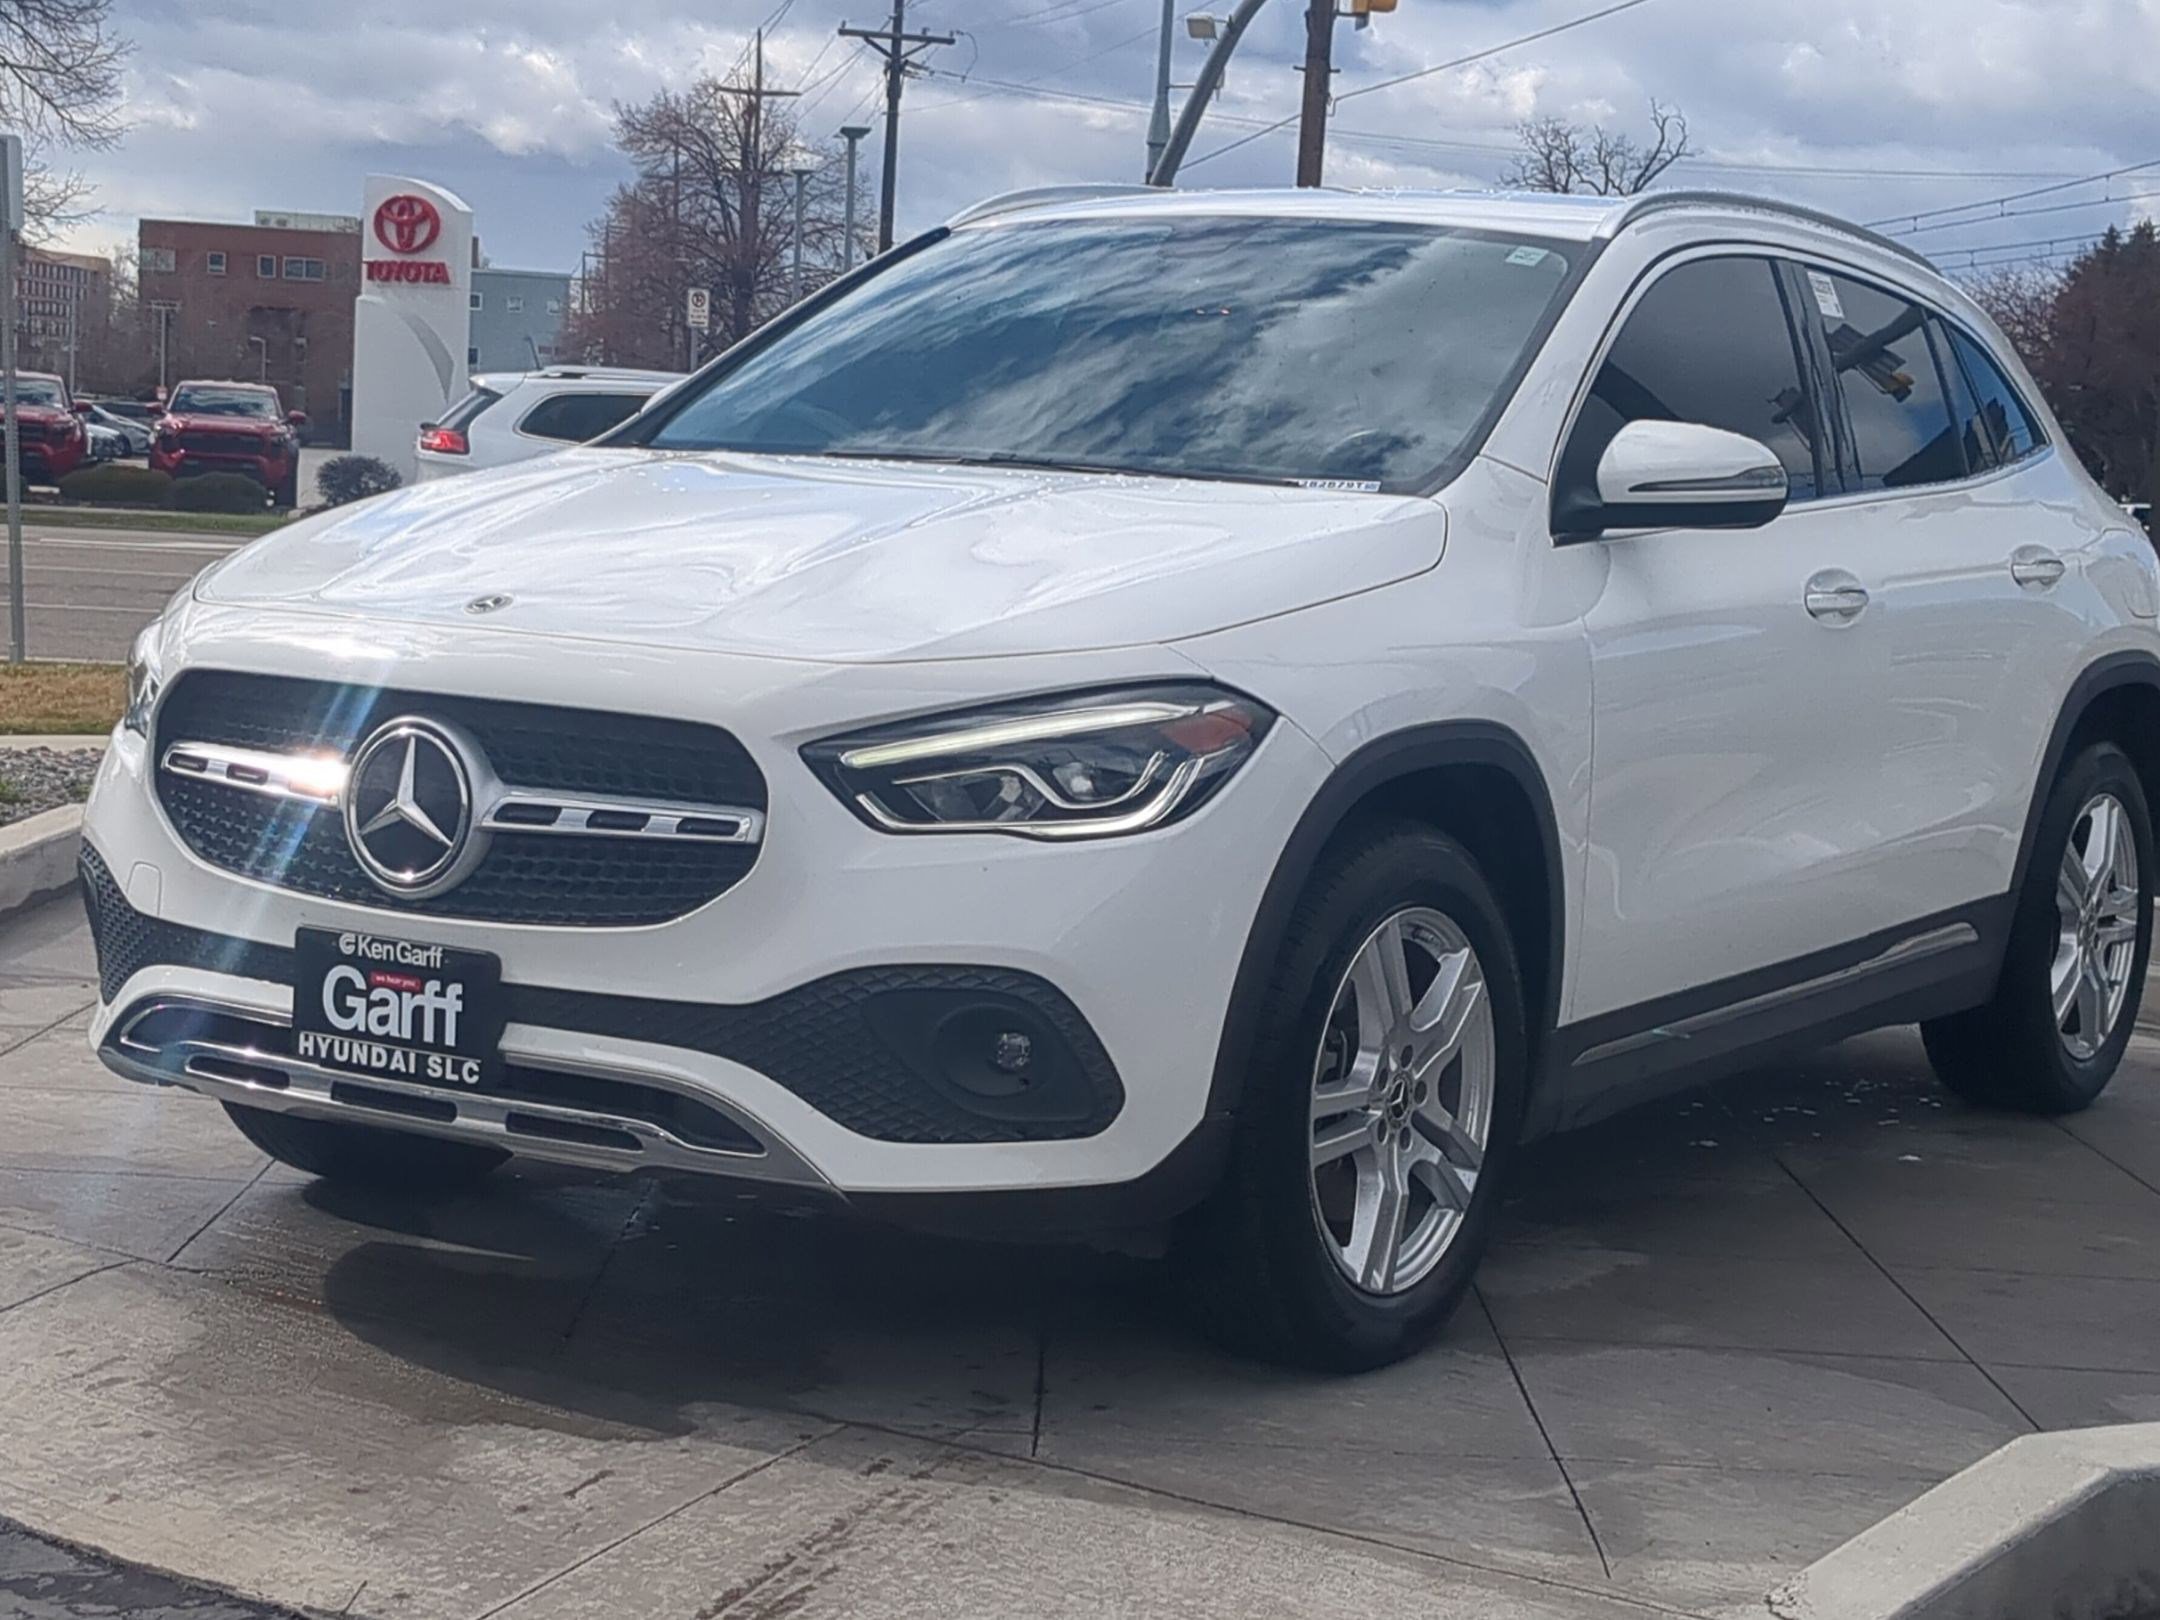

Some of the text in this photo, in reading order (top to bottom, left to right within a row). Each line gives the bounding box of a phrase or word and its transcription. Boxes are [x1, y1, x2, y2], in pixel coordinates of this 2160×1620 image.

[363, 260, 451, 284] TOYOTA
[322, 964, 463, 1047] Garff
[298, 1033, 480, 1084] HYUNDAI SLC
